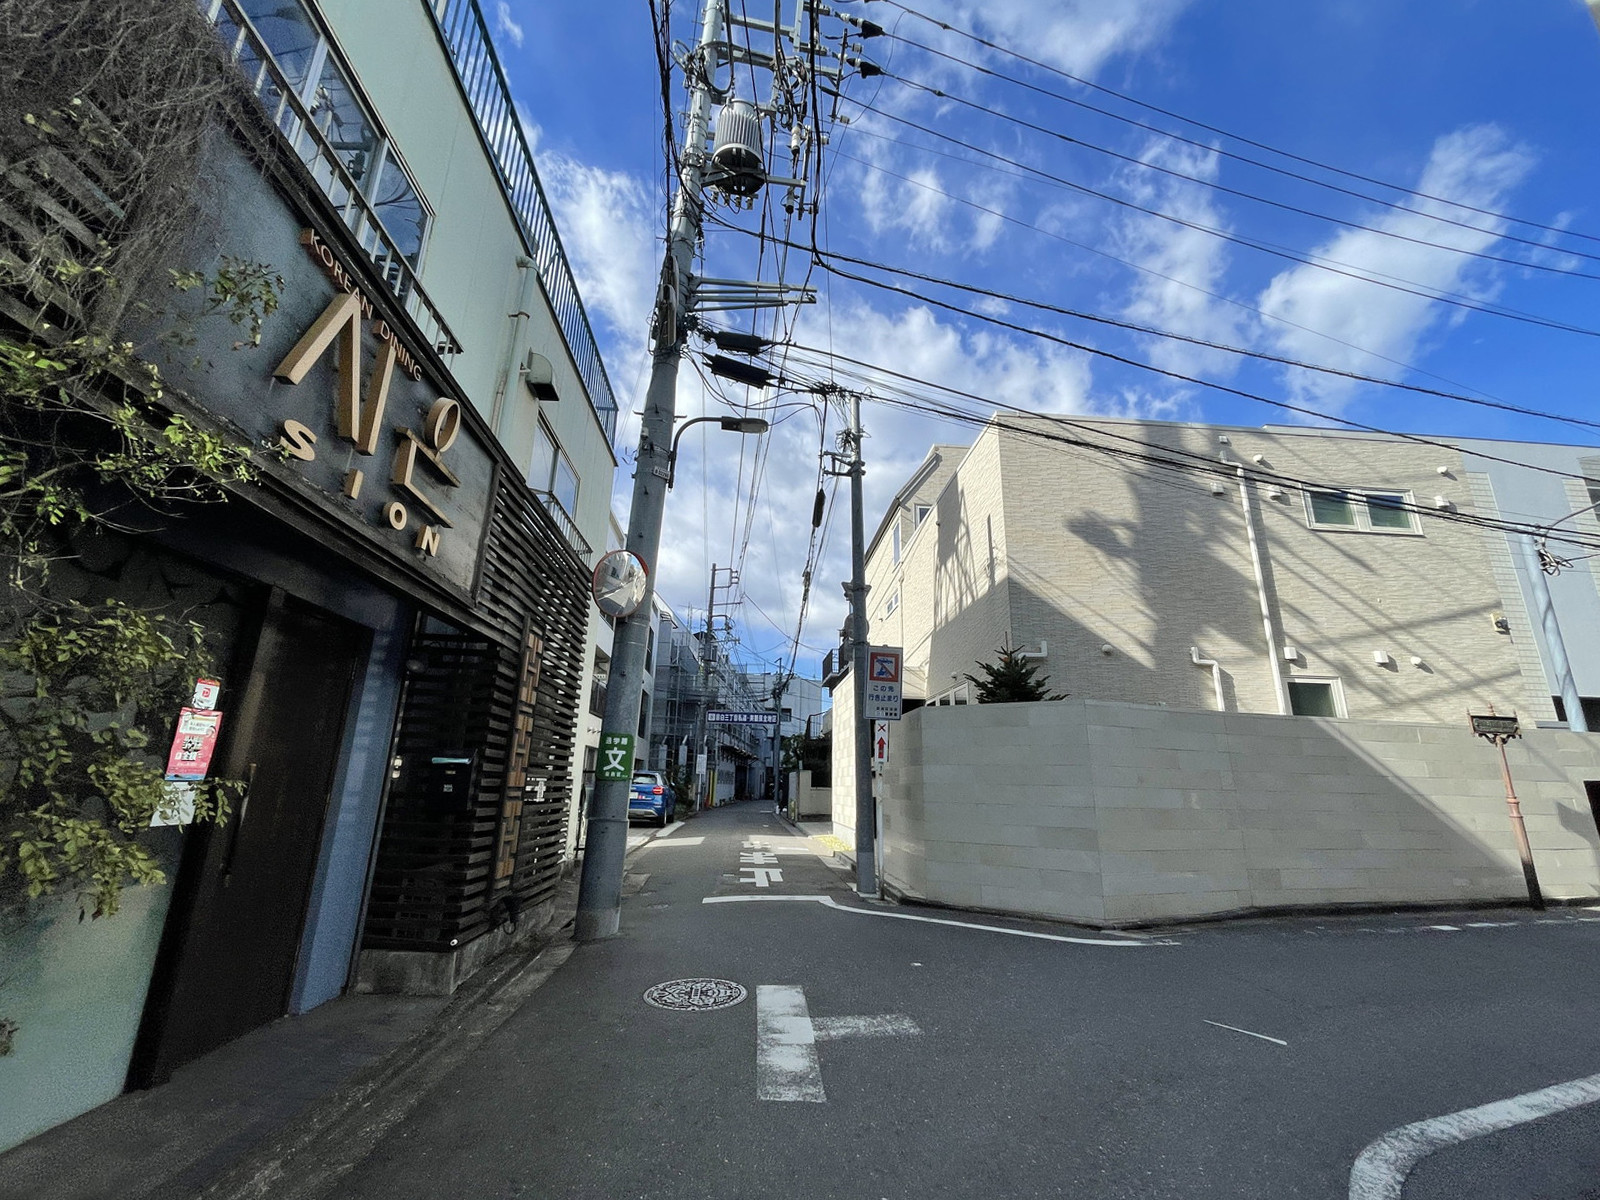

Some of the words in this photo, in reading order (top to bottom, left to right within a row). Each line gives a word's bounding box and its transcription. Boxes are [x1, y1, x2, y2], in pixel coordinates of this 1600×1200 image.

[310, 227, 374, 320] KOREAN
[379, 320, 423, 382] DINING
[280, 419, 441, 558] SION
[872, 685, 895, 693] この先
[868, 693, 899, 703] 行き止まり
[605, 737, 628, 746] 通学路
[603, 747, 626, 771] 文
